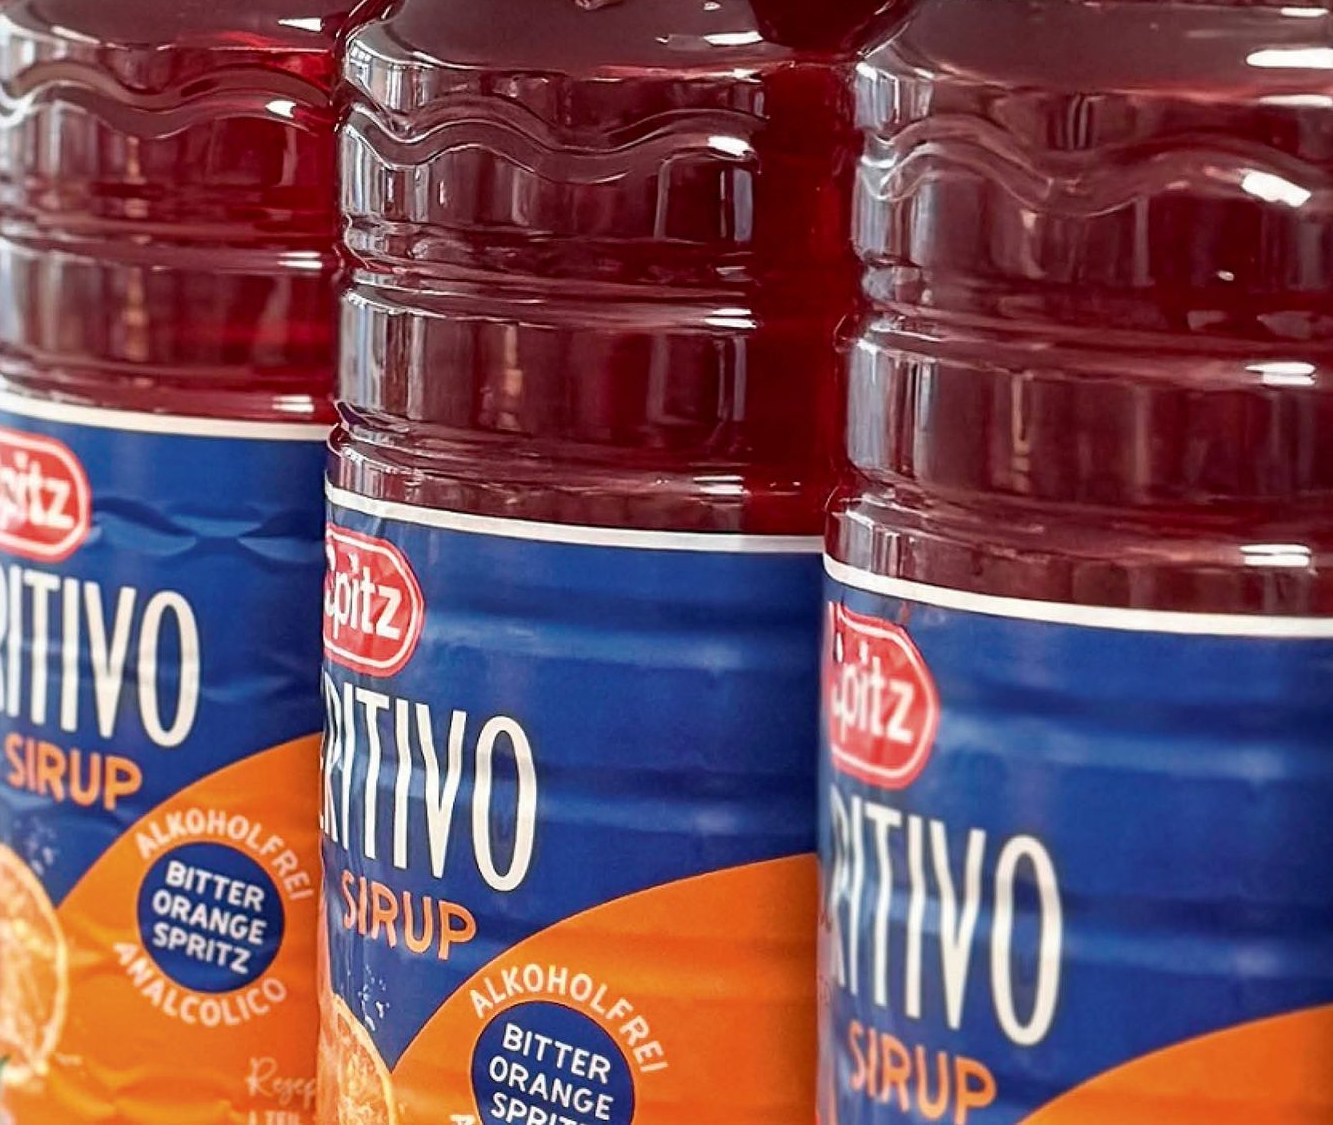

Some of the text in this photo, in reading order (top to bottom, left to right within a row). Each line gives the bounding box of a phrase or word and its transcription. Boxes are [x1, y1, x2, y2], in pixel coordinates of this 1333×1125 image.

[4, 733, 142, 811] SIRUP
[319, 672, 537, 892] RITIVO
[134, 808, 314, 901] ALKOHOLFREI
[165, 860, 266, 913] BITTER
[151, 889, 267, 945] ORANGE
[152, 922, 253, 975] SPRITZ
[342, 870, 478, 961] SIRUP
[112, 940, 287, 1027] ANALCOLICO
[469, 963, 668, 1073] ALKOHOLFREI
[489, 1055, 615, 1121] ORANGE
[502, 1022, 612, 1085] BITTER
[848, 1019, 996, 1125] SIRUP
[490, 1091, 589, 1125] SPR
